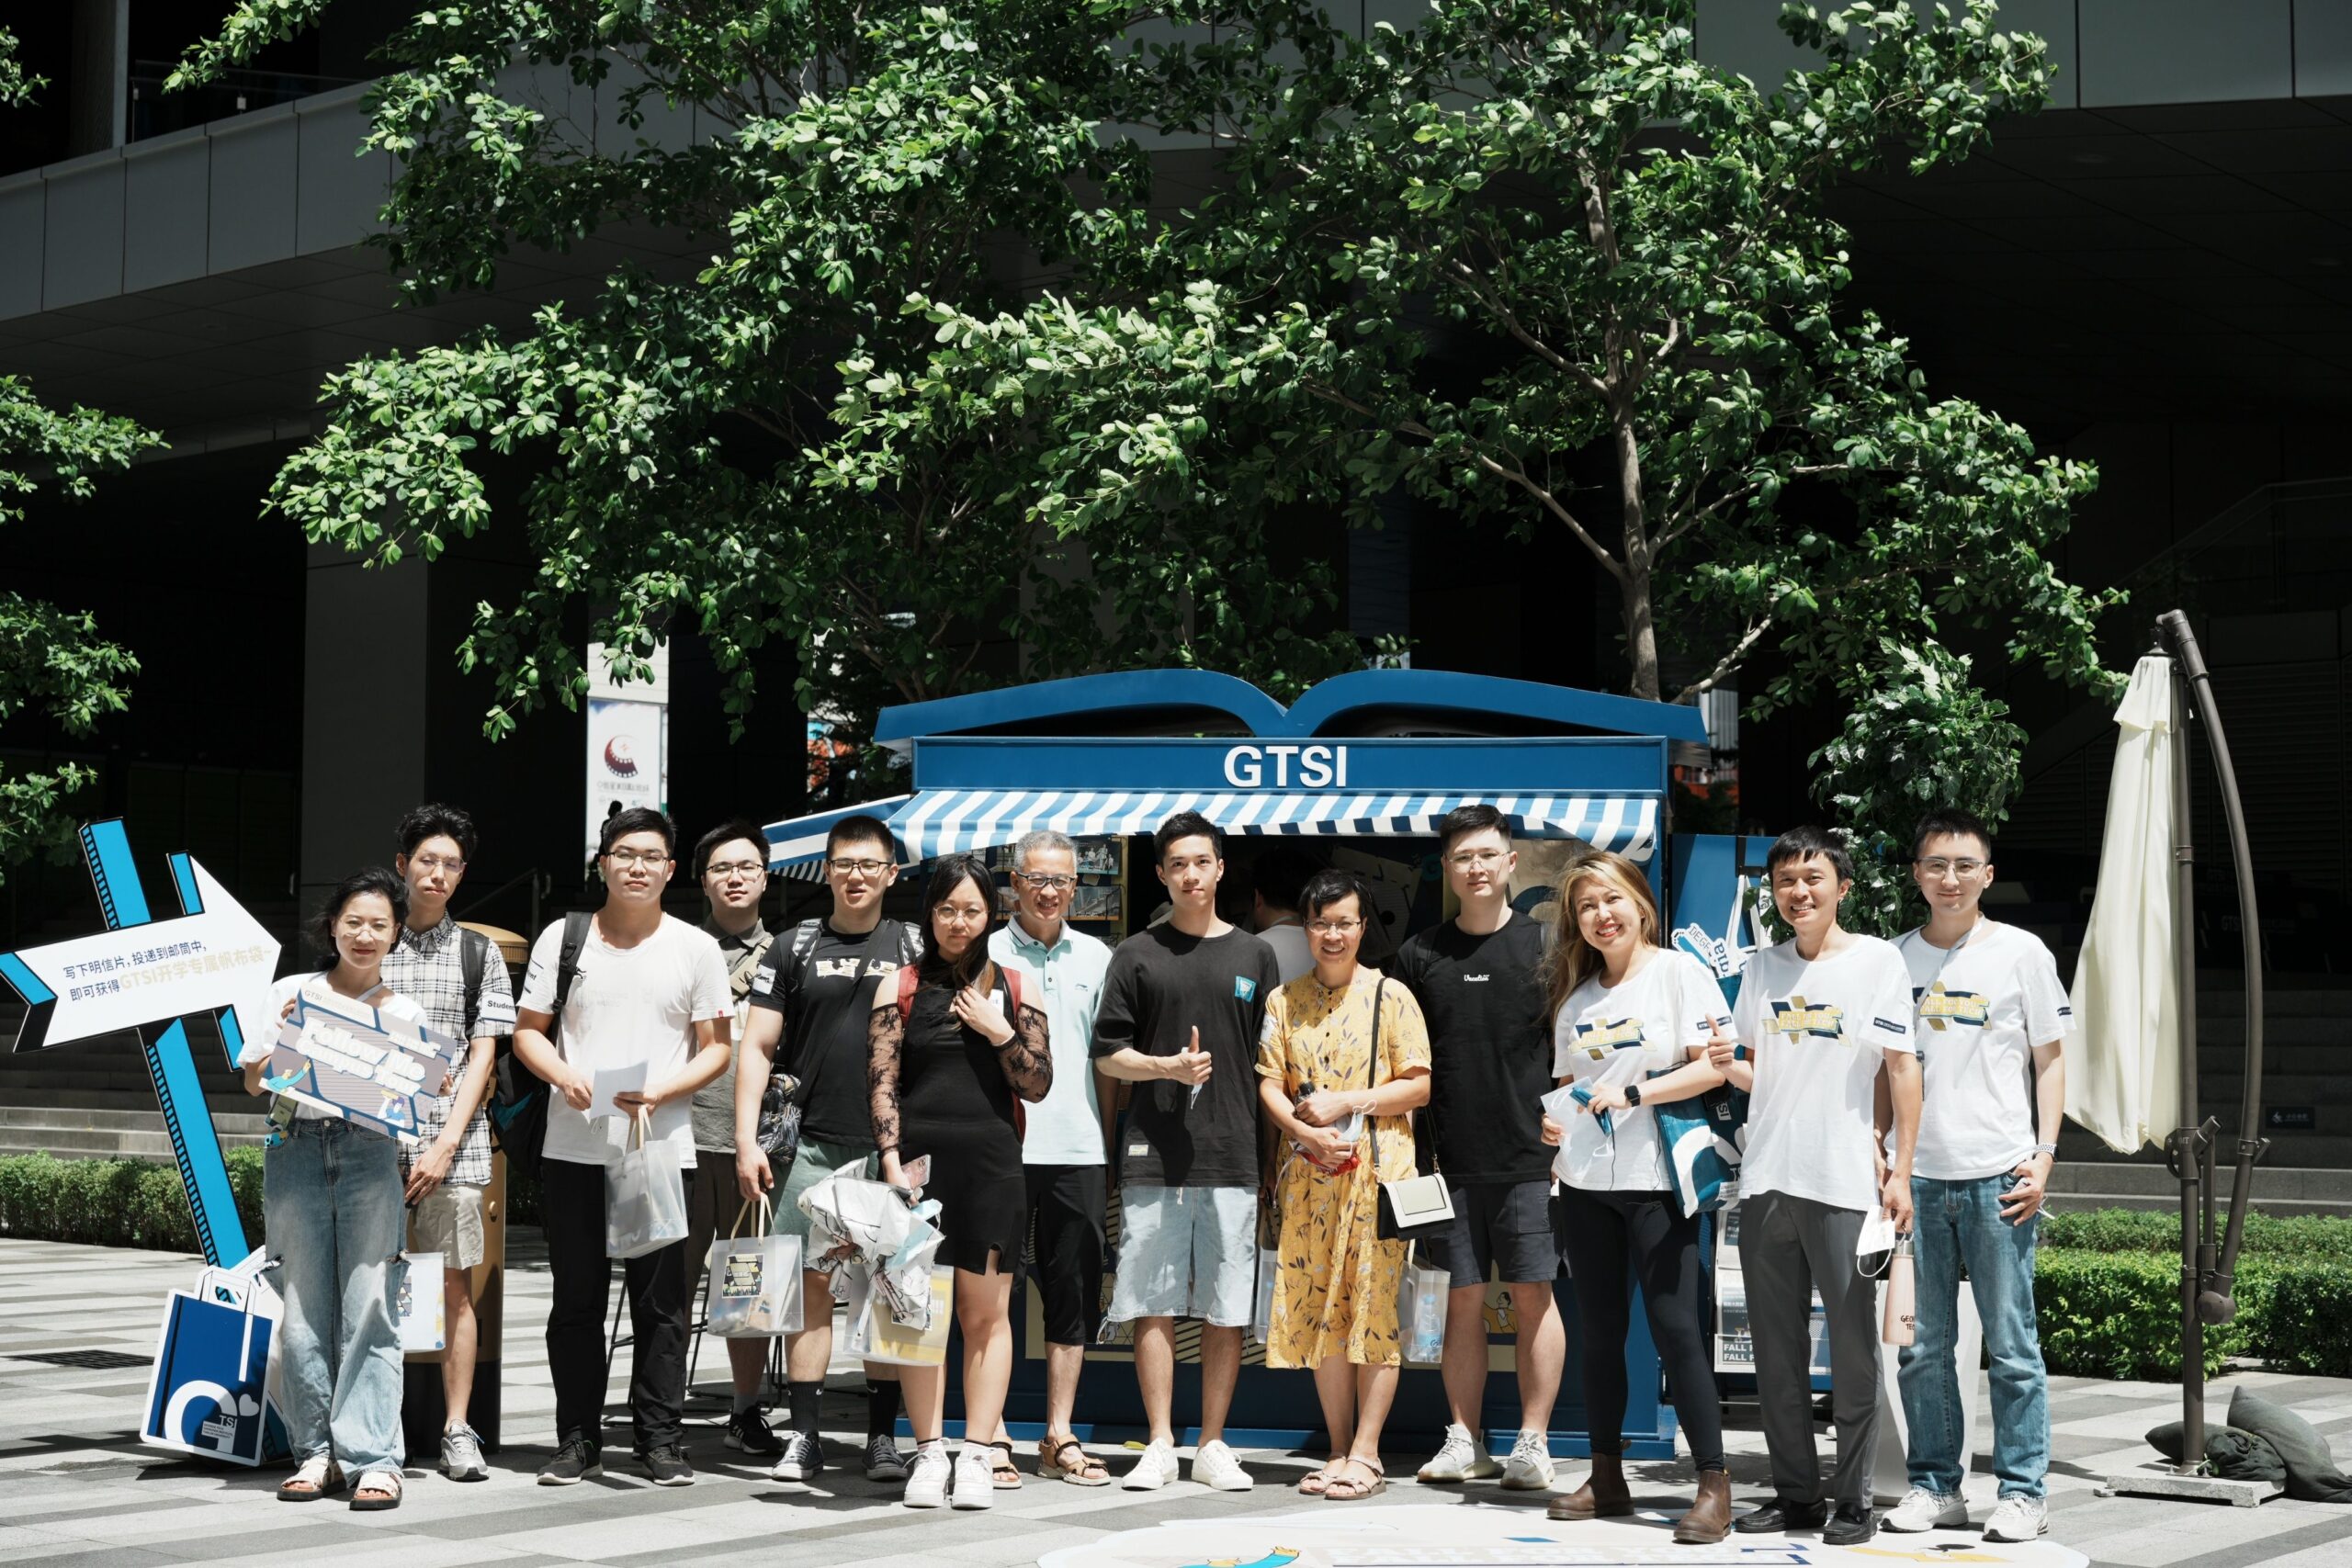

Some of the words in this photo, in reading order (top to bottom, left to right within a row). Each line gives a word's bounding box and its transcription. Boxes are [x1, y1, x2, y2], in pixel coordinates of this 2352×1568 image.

[1224, 745, 1347, 787] GTSI
[304, 989, 323, 1001] GTSI
[487, 999, 515, 1011] Student
[302, 1016, 388, 1065] Follow
[386, 1048, 425, 1081] Me
[1724, 1343, 1747, 1352] FALL
[1724, 1353, 1747, 1361] FALL
